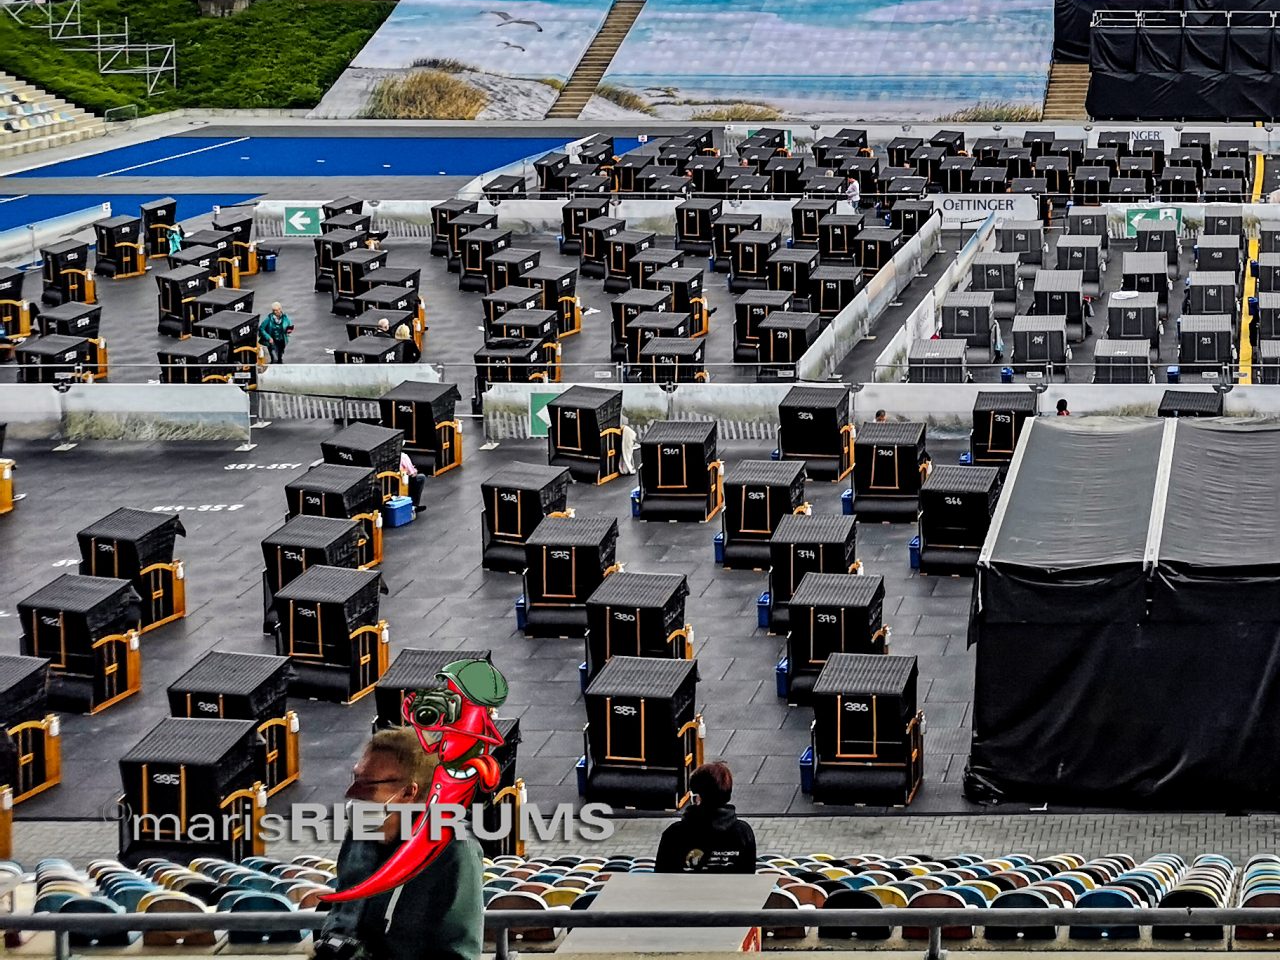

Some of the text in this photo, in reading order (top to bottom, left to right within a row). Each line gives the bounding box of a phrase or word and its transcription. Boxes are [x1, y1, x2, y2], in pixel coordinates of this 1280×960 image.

[797, 412, 813, 421] 354
[994, 415, 1010, 423] 353
[663, 448, 679, 456] 361
[501, 492, 518, 502] 368
[749, 492, 765, 500] 367
[306, 496, 321, 506] 369
[945, 497, 962, 505] 366
[284, 550, 303, 561] 376
[551, 550, 570, 560] 375
[797, 550, 815, 559] 374
[298, 607, 317, 618] 381
[614, 612, 635, 621] 380
[817, 614, 837, 623] 379
[198, 702, 218, 712] 389
[614, 706, 637, 716] 387
[844, 702, 869, 711] 386
[153, 774, 180, 785] 395
